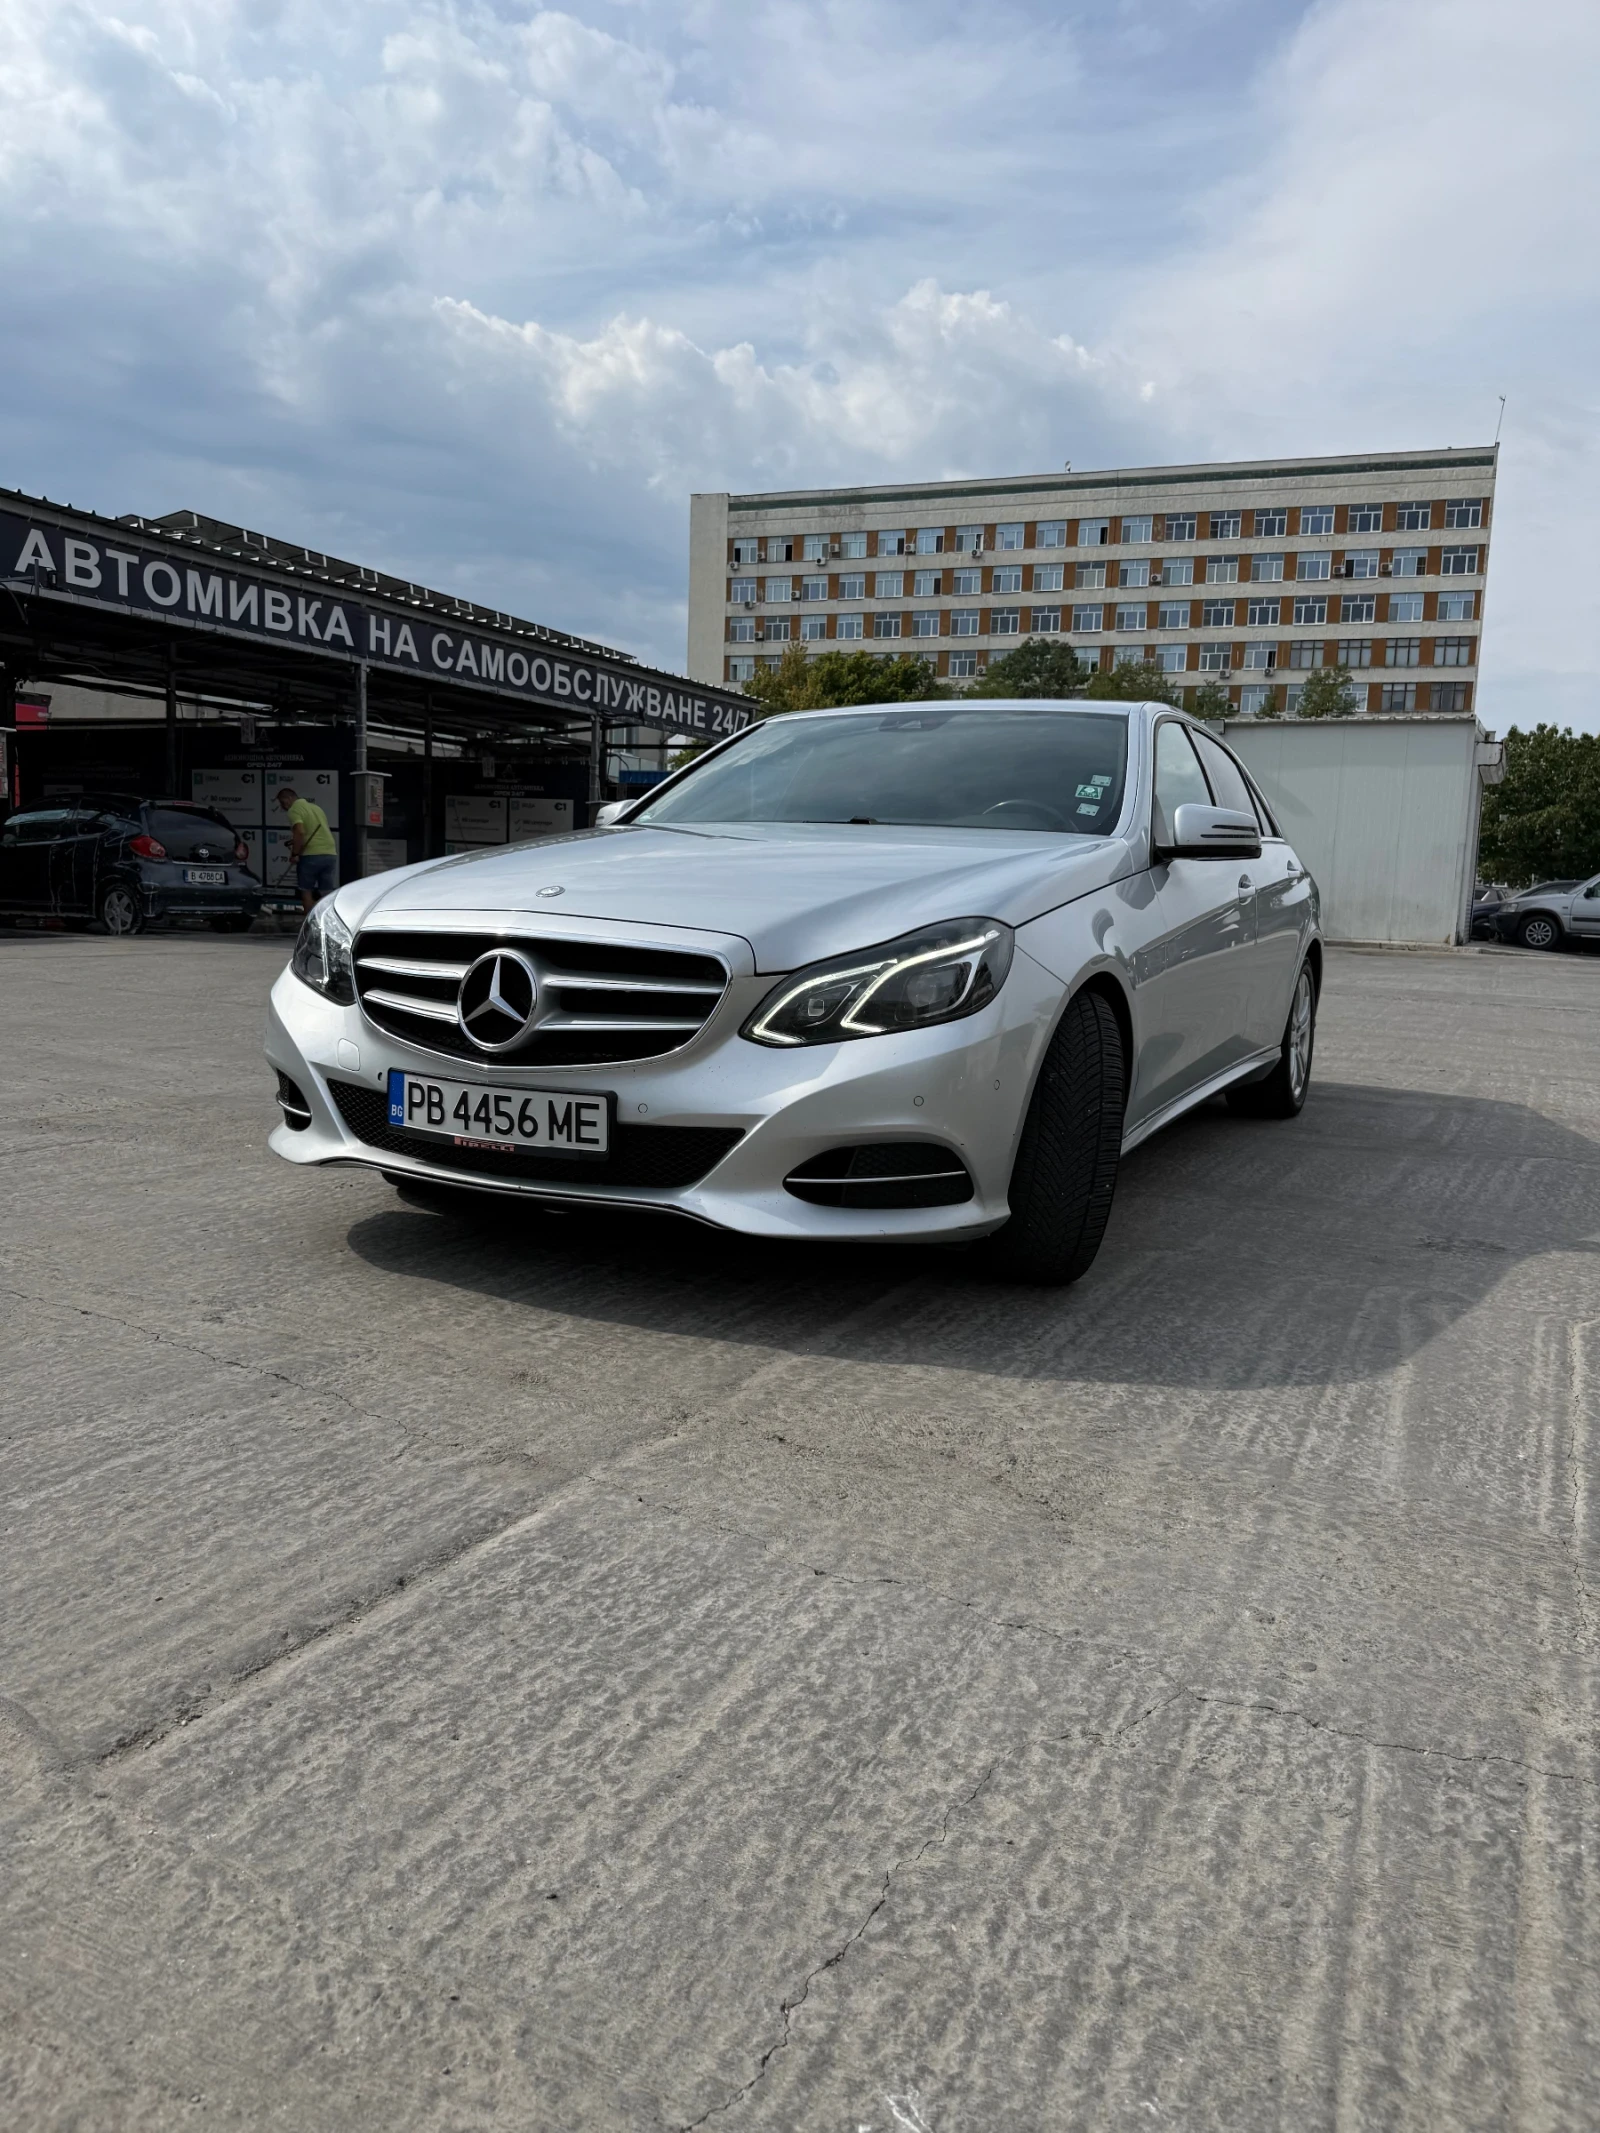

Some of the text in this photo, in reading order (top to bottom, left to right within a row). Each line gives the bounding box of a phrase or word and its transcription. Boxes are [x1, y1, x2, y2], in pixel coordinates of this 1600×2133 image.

[15, 528, 749, 734] АВТОМИВКА НА САМООБСЛУЖВАНЕ 24/7
[241, 773, 255, 784] €1
[316, 774, 330, 784] €1
[391, 1103, 403, 1117] BG
[408, 1081, 600, 1145] PB 4456 ME
